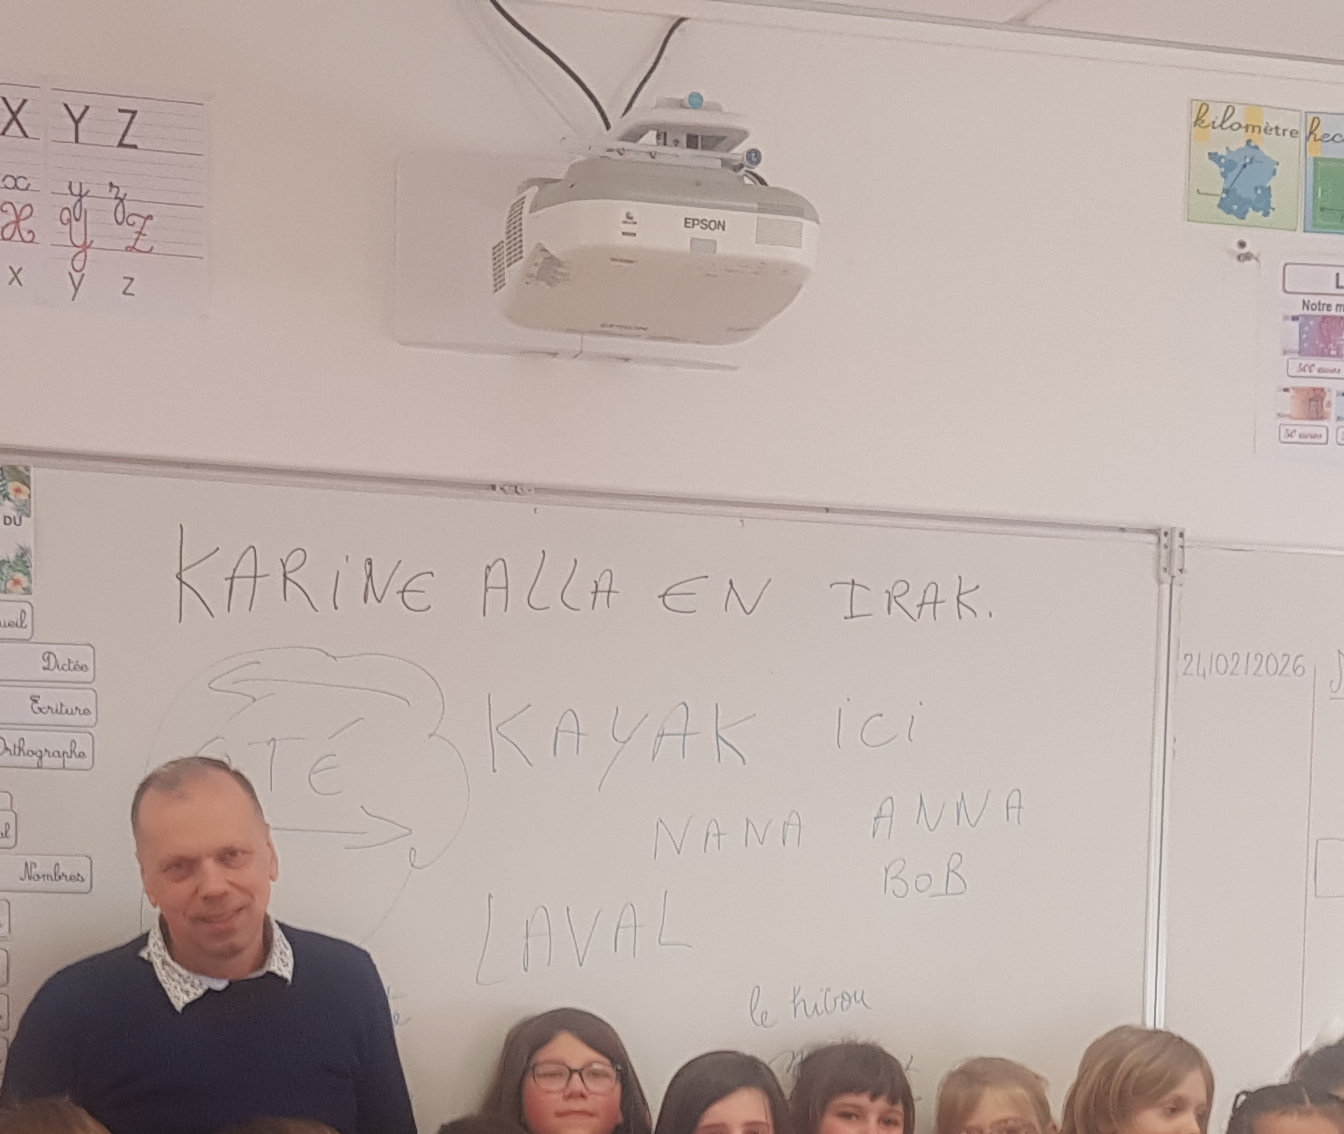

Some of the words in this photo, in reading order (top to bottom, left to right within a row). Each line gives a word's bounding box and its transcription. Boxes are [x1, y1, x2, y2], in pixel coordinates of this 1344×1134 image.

[0, 96, 29, 138] X
[63, 103, 90, 144] Y
[116, 108, 139, 149] Z
[1192, 103, 1299, 138] kilomètre
[684, 217, 726, 232] EPSON
[7, 265, 24, 288] x
[68, 272, 86, 301] y
[121, 277, 135, 297] z
[1302, 299, 1333, 313] Notre
[3, 514, 23, 528] DU
[482, 549, 620, 617] ALLA
[658, 574, 772, 616] EN
[829, 575, 994, 623] IRAK.
[42, 650, 90, 673] Dictée
[487, 692, 757, 791] KAYAK
[656, 812, 804, 860] NANA
[872, 789, 1025, 840] ANNA
[19, 862, 86, 884] Nombres
[475, 891, 693, 985] LAVAL
[749, 985, 779, 1028] le
